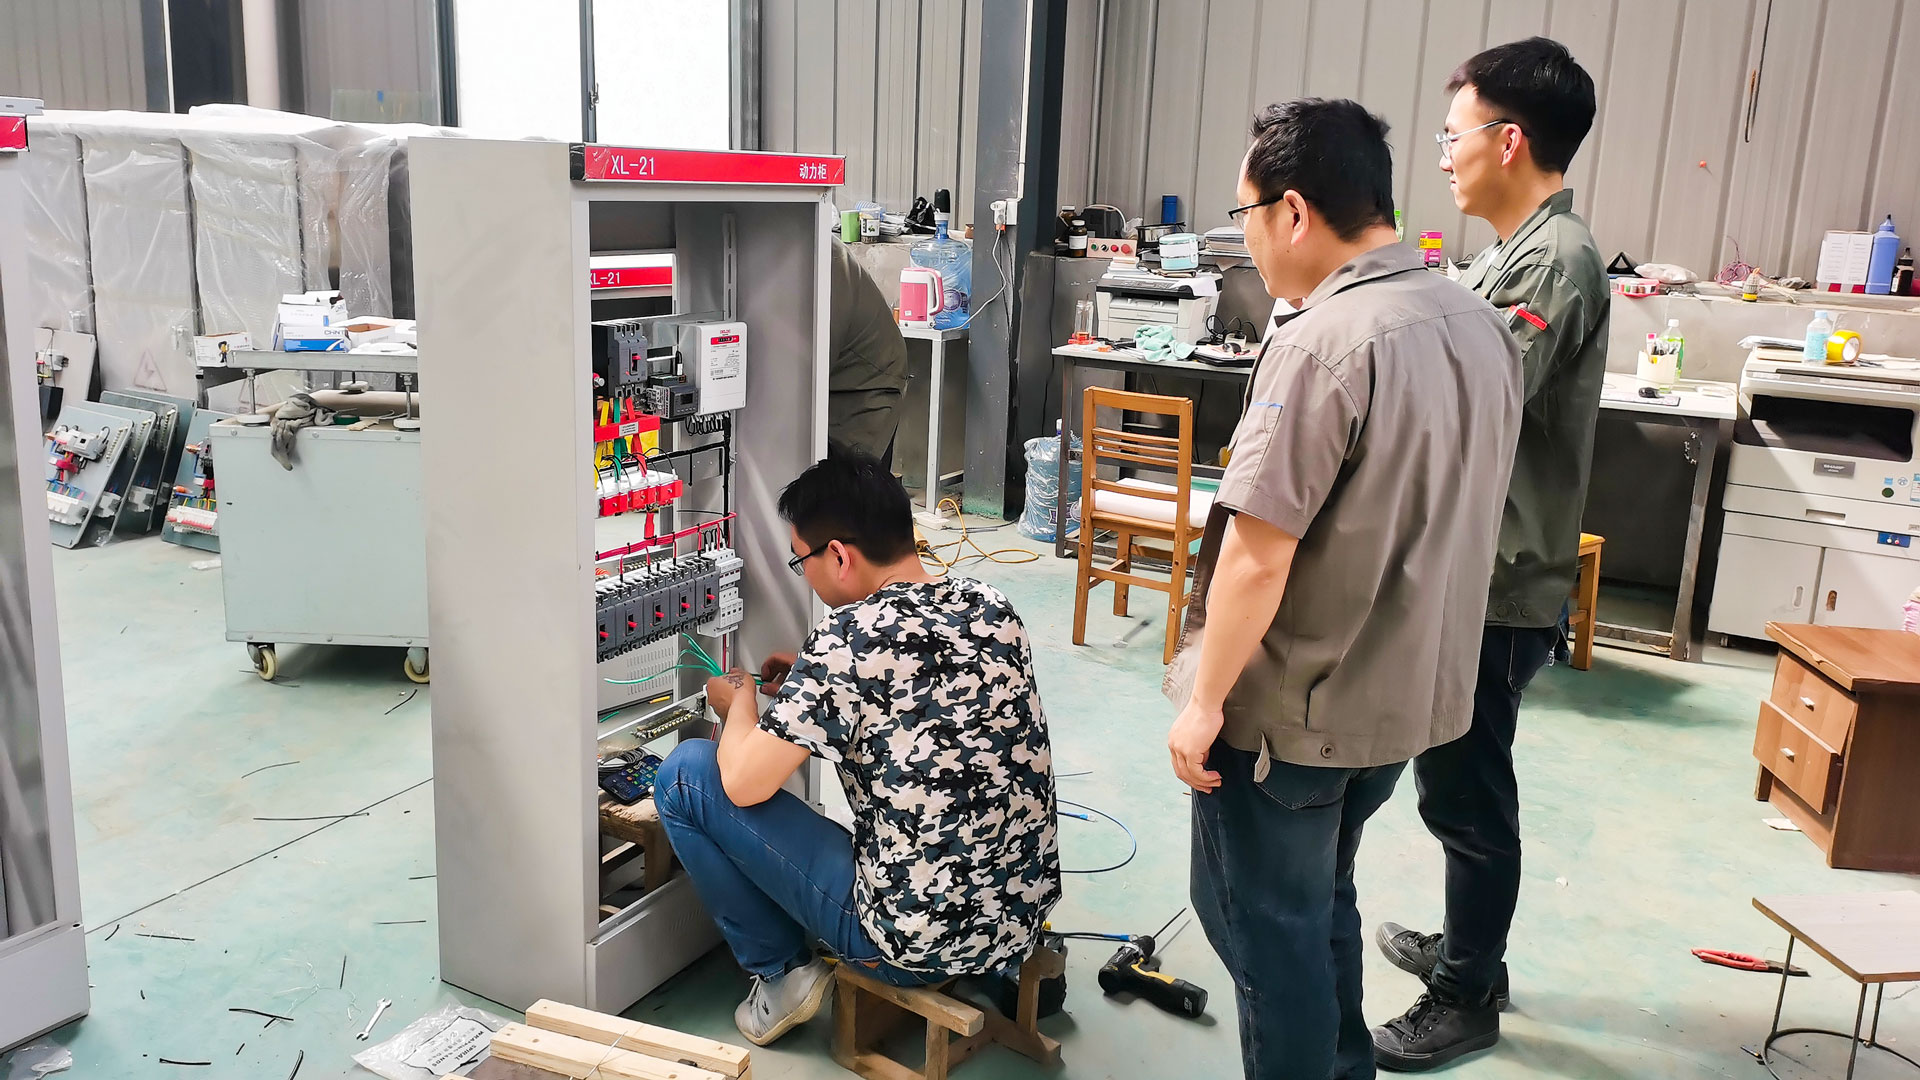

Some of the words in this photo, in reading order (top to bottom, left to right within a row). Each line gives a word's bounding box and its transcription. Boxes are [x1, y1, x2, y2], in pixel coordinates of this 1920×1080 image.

[610, 154, 654, 176] XL-21
[799, 162, 827, 180] 动力柜
